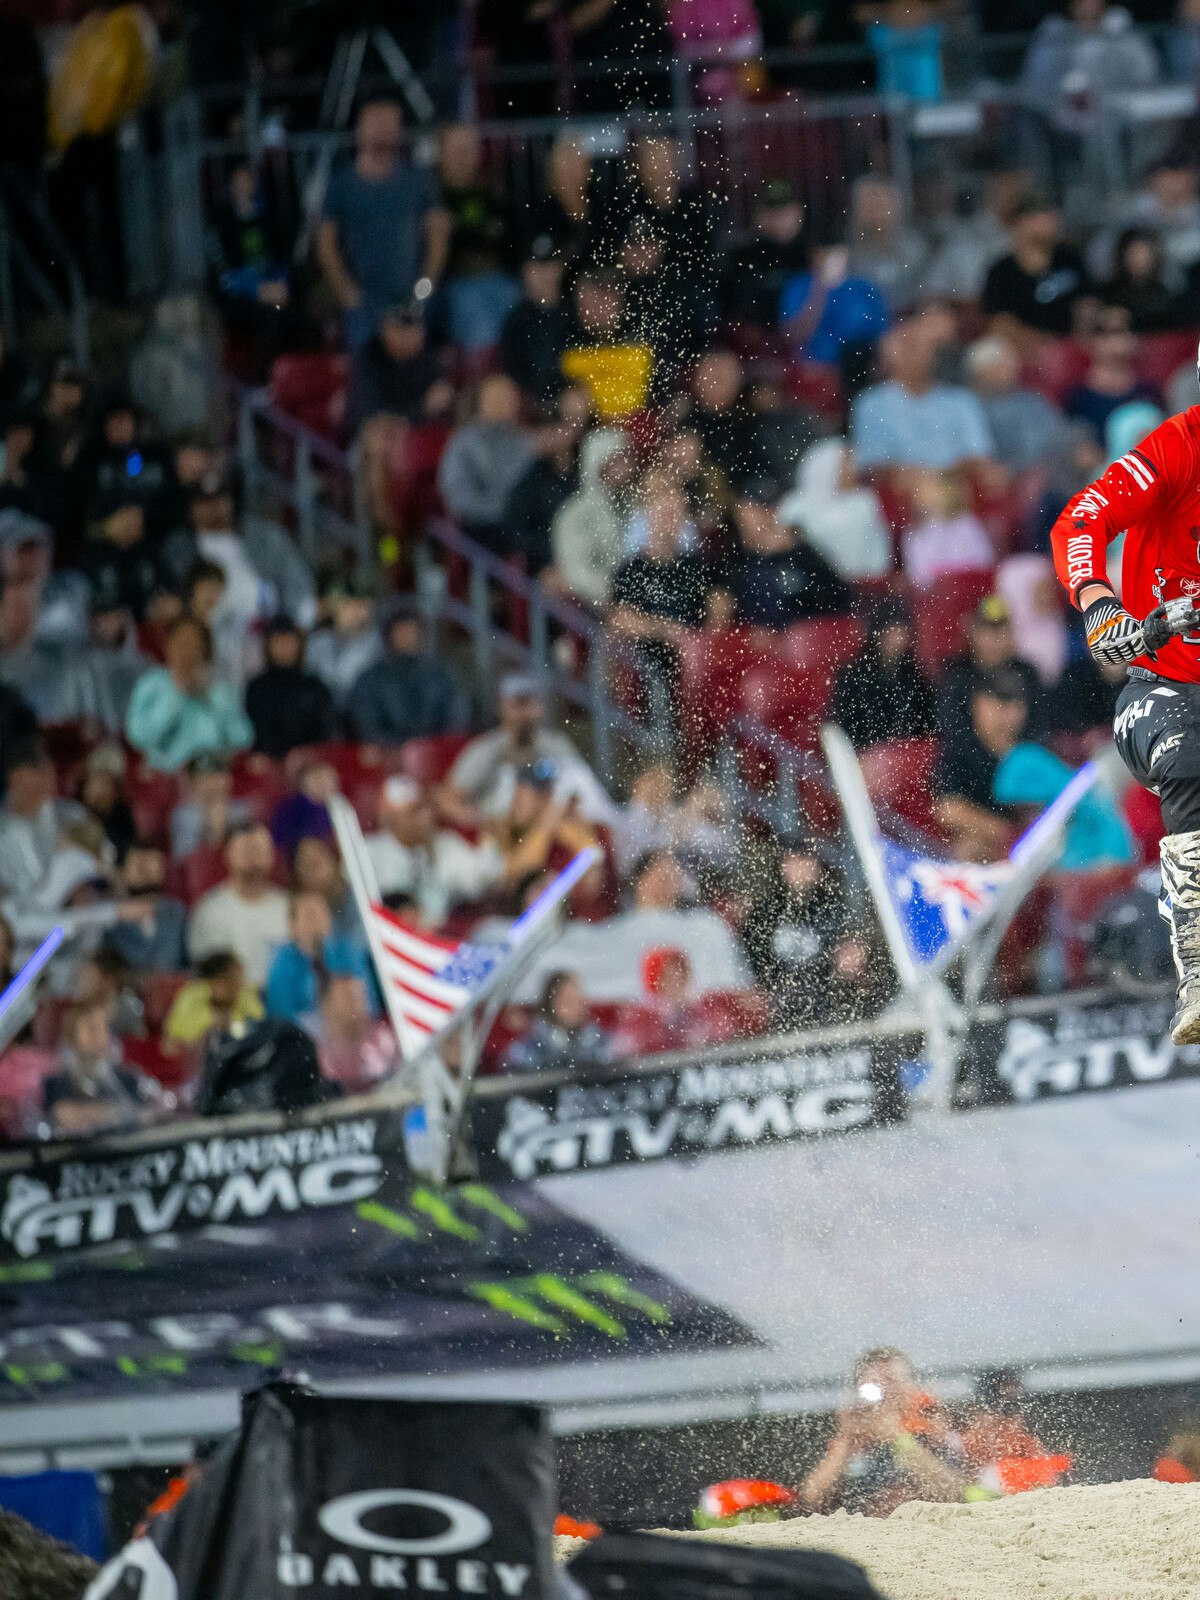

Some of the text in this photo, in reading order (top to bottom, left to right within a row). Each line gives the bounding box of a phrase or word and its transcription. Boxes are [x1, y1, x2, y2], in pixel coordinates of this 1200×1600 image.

[1071, 487, 1109, 520] KING
[183, 1119, 377, 1182] MOUNTAIN
[277, 1551, 530, 1597] OAKLEY
